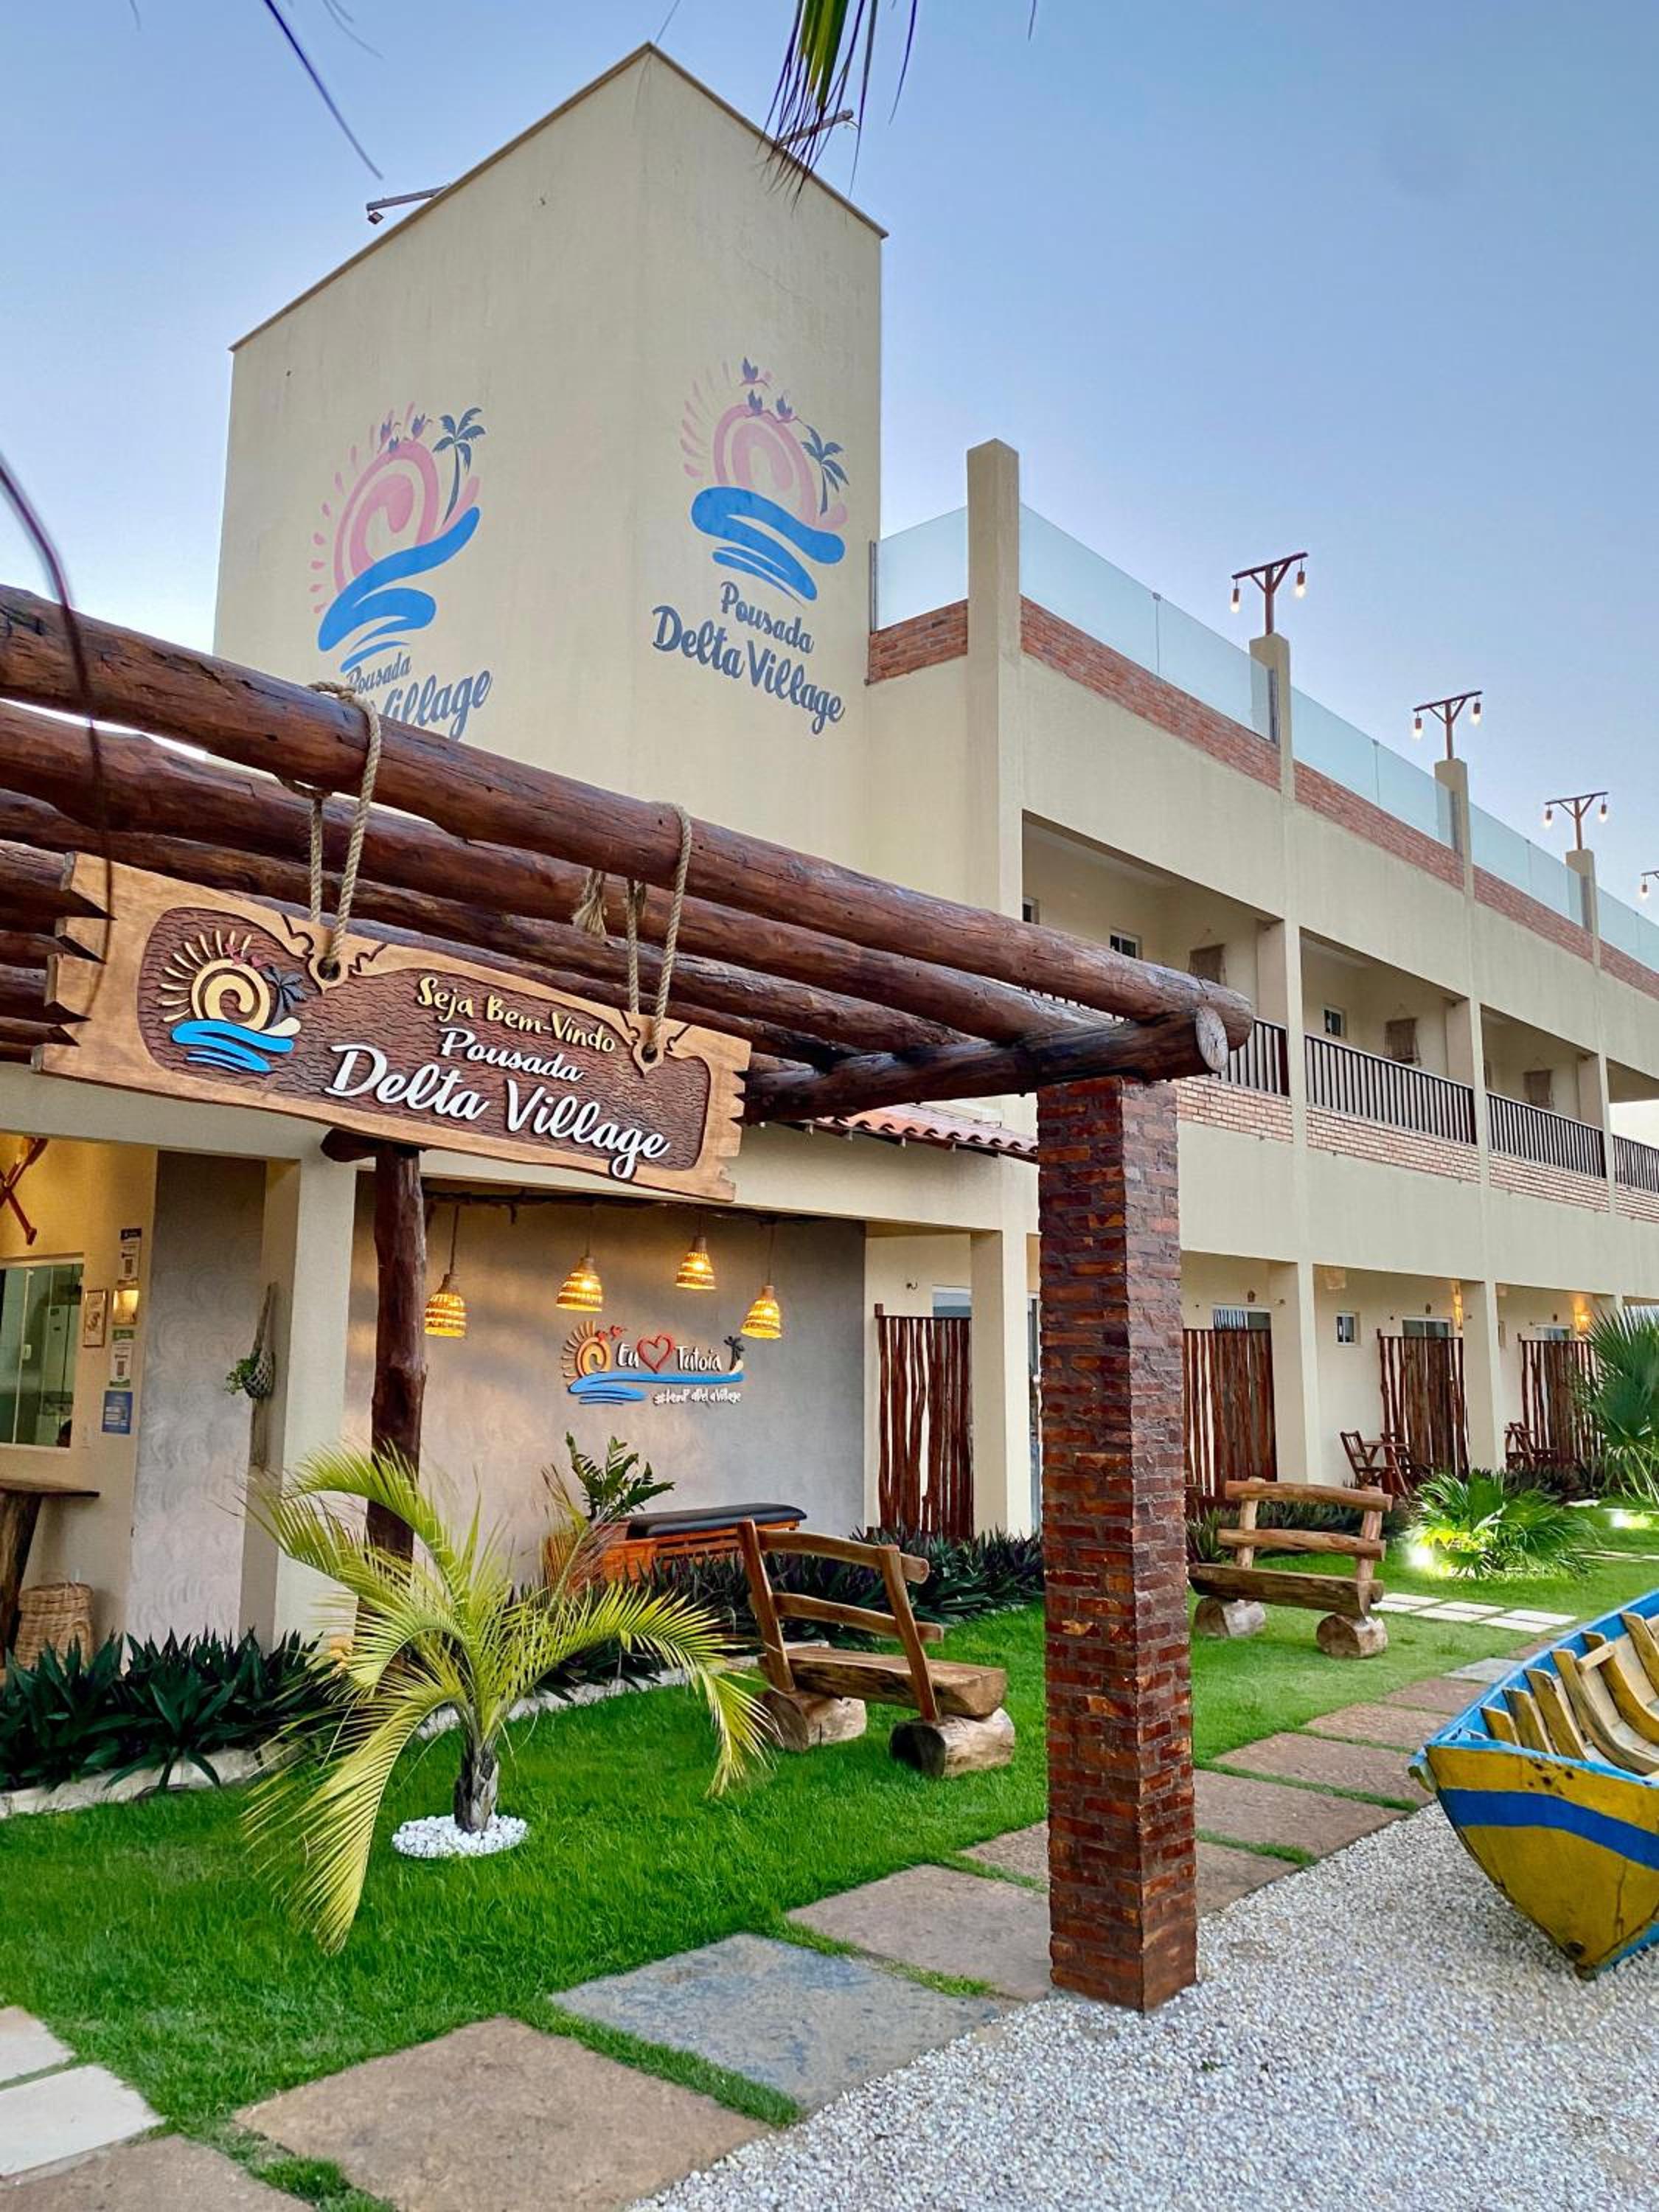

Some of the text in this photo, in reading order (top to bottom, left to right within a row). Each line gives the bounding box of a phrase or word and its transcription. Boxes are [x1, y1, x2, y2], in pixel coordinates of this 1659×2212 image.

[720, 581, 814, 653] Pousada
[346, 652, 411, 695] Pousada
[652, 605, 845, 734] Delta Village
[417, 977, 615, 1052] Seja Bem-Vindo
[439, 1027, 584, 1082] Pousada
[324, 1044, 670, 1178] Delta Village
[617, 1343, 639, 1368] Eu
